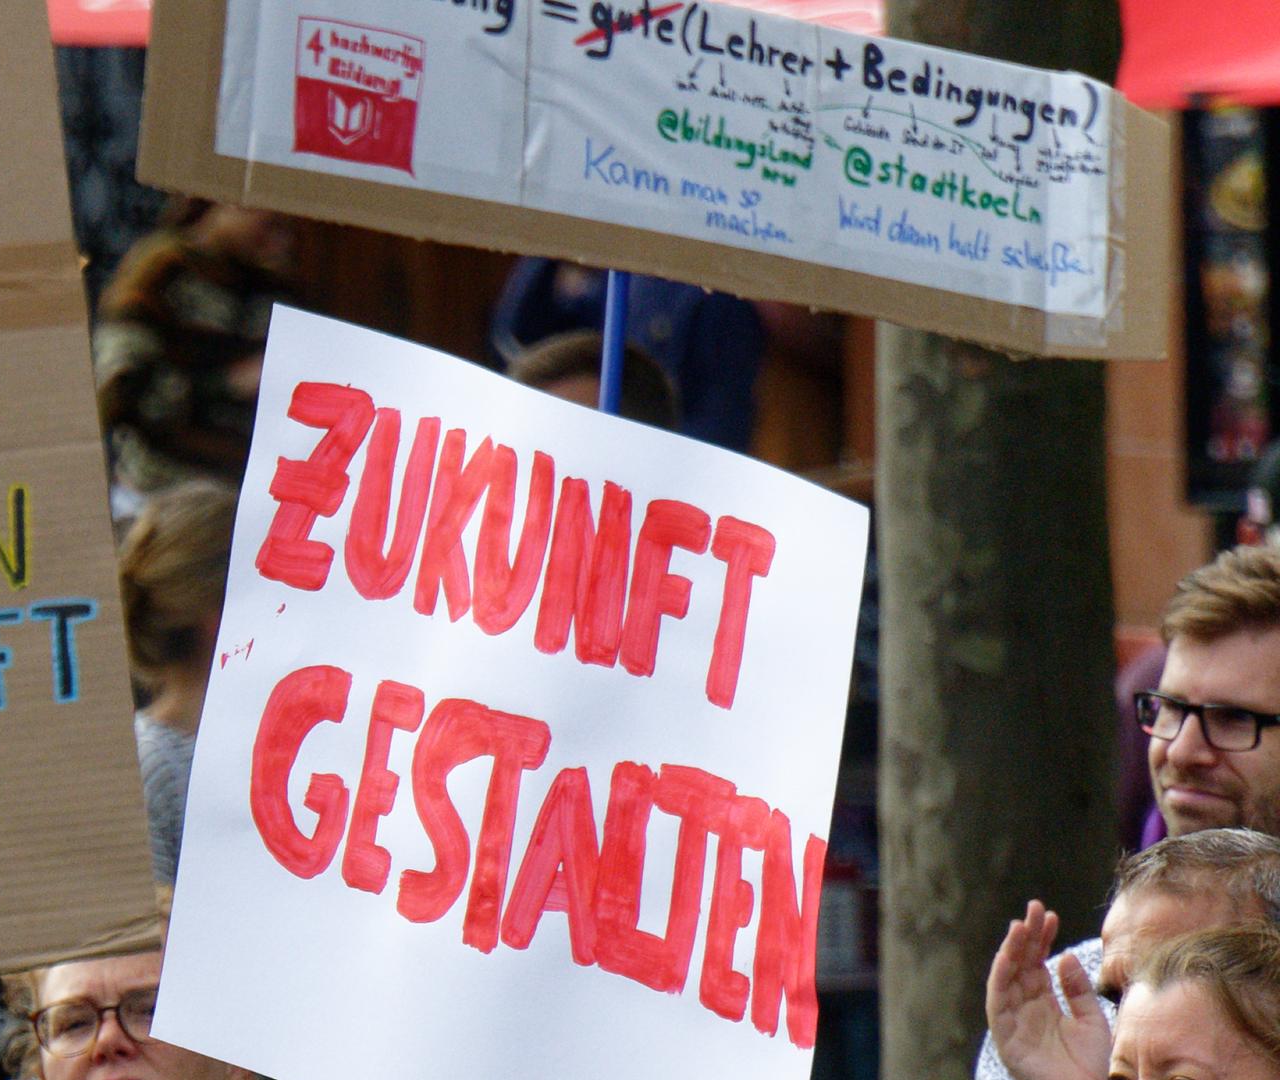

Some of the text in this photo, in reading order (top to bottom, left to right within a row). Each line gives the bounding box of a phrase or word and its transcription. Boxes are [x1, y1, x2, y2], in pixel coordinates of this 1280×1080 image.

[306, 28, 325, 66] 4
[584, 136, 670, 196] Kann
[681, 175, 729, 205] man
[255, 381, 776, 710] ZUKUNFT
[249, 664, 829, 1050] GESTALTEN
